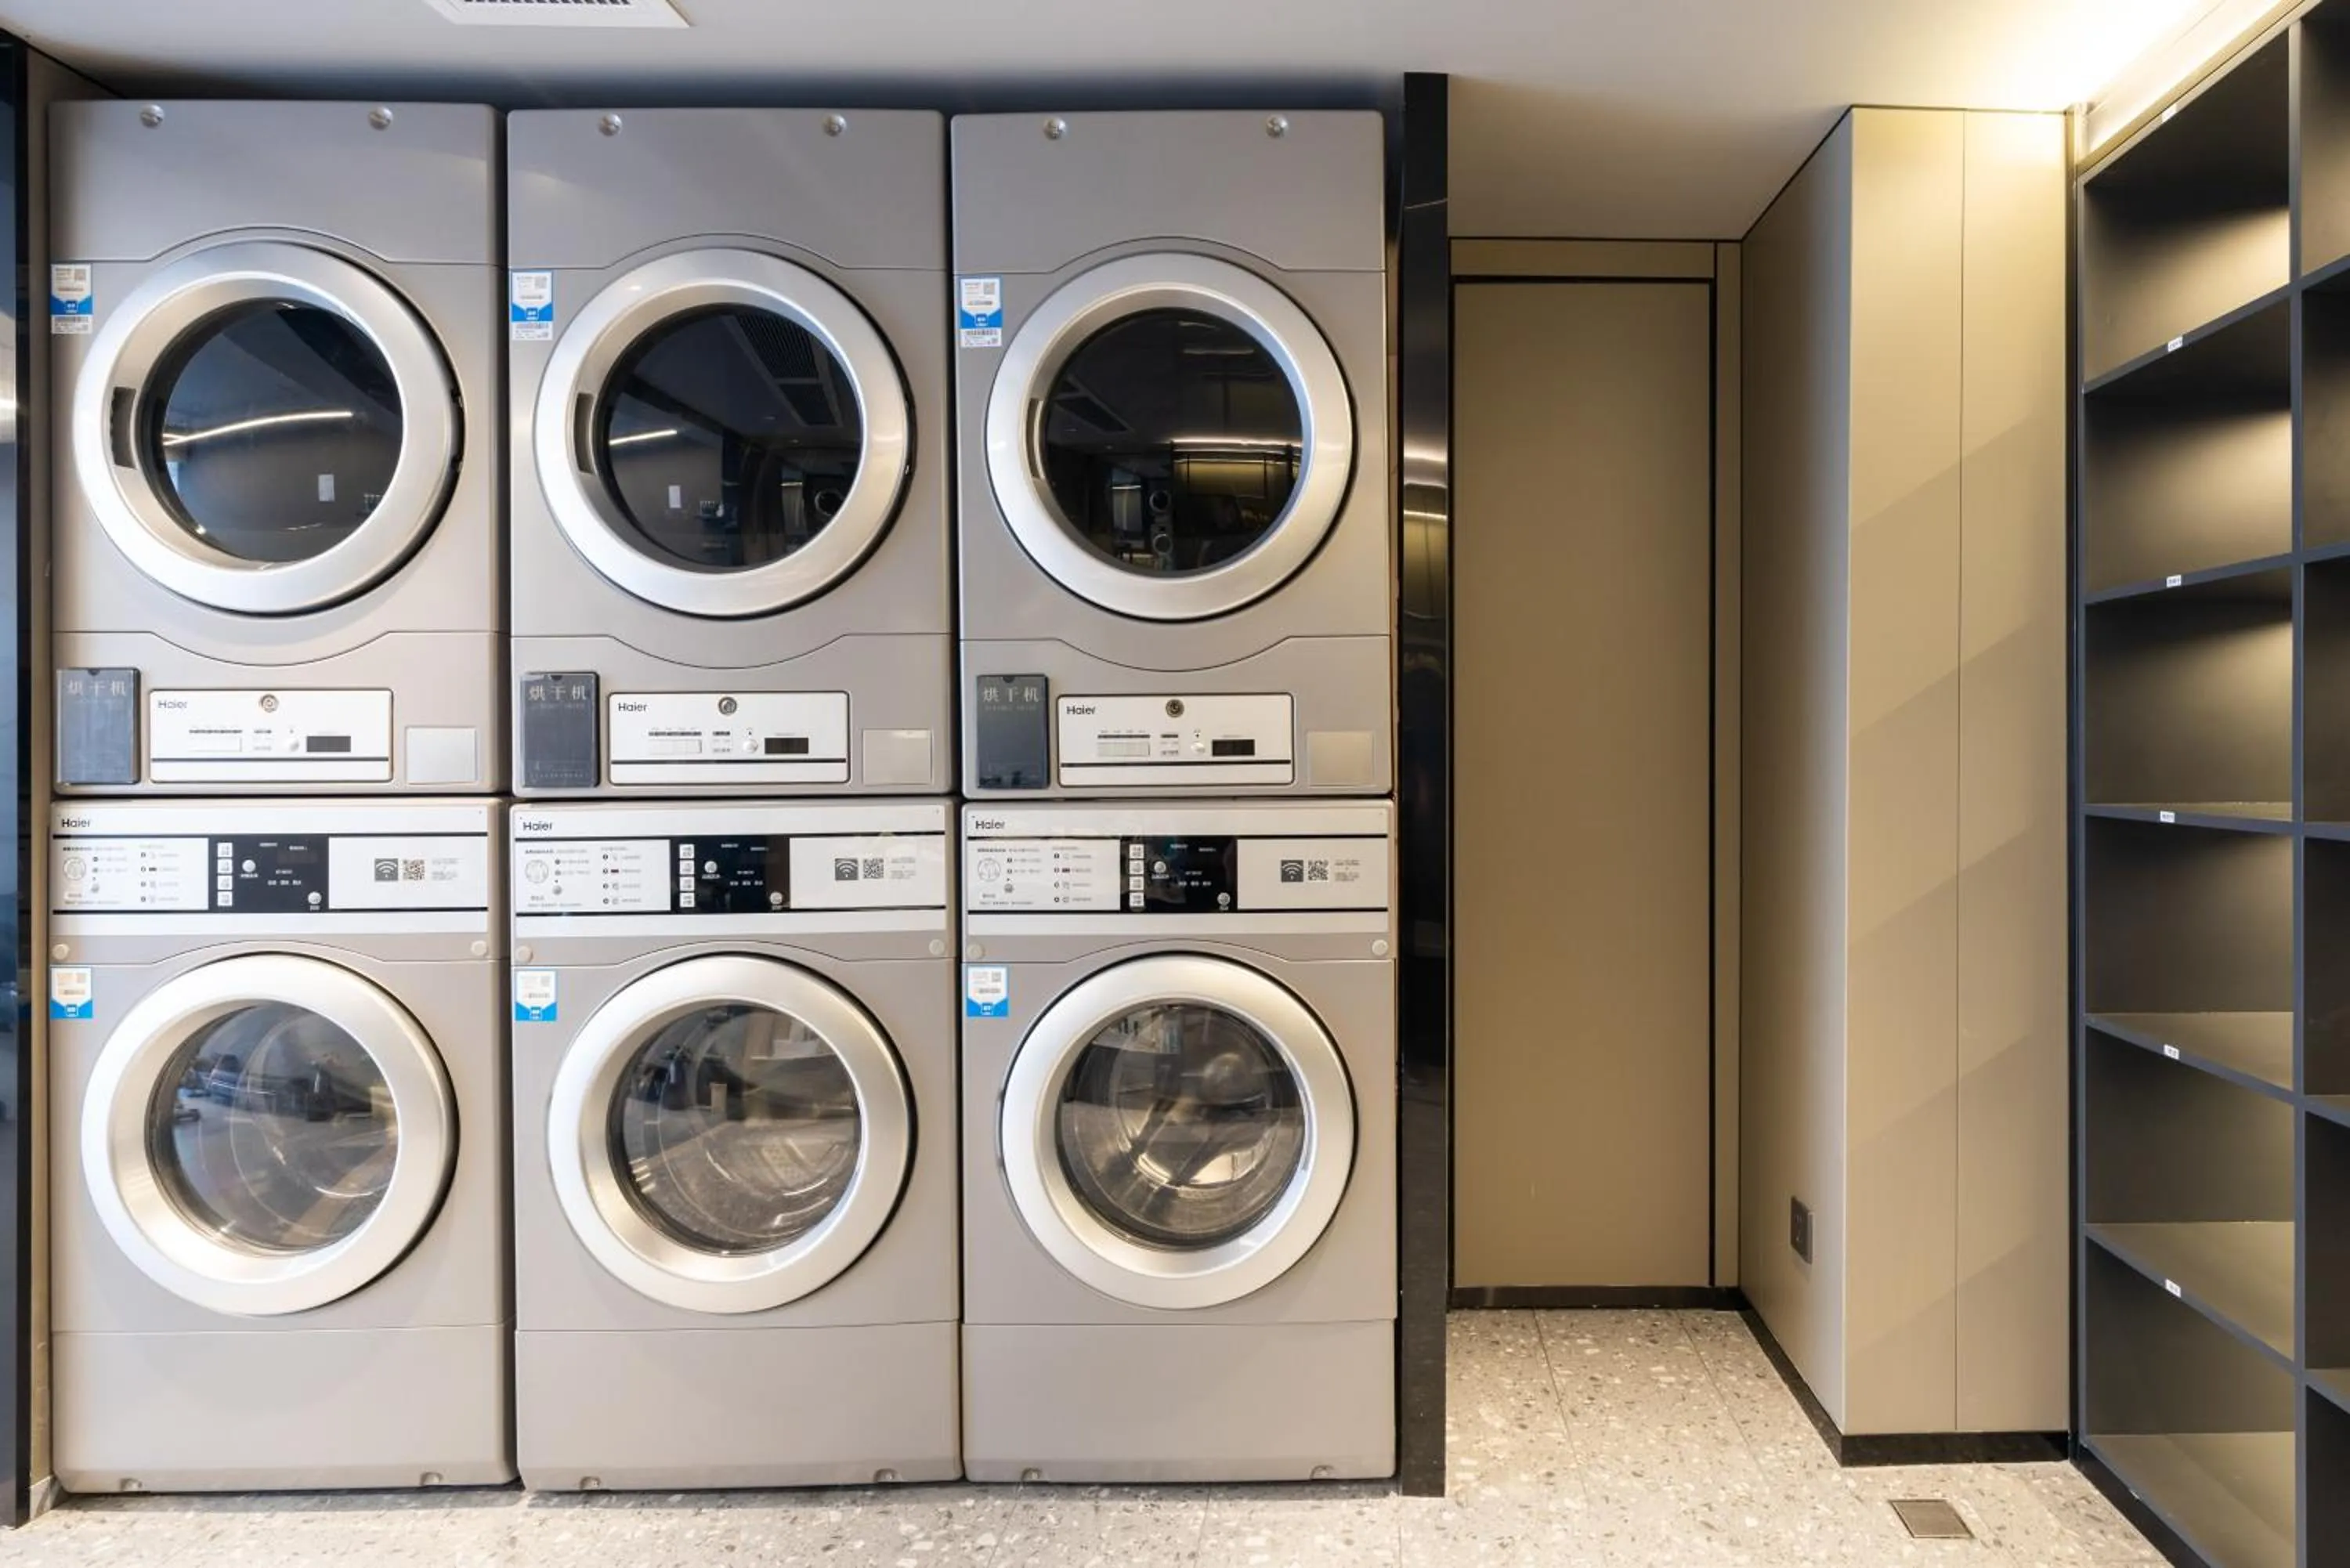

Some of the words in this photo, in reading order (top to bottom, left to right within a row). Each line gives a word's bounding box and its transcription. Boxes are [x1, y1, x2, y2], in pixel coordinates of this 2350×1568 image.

[529, 685, 587, 701] 烘干机
[983, 686, 1039, 703] 烘干机
[157, 700, 187, 709] Haier
[618, 703, 648, 712] Haier
[1066, 705, 1096, 715] Haier
[61, 817, 90, 828] Haier
[522, 820, 552, 831] Haier
[975, 819, 1005, 829] Haier
